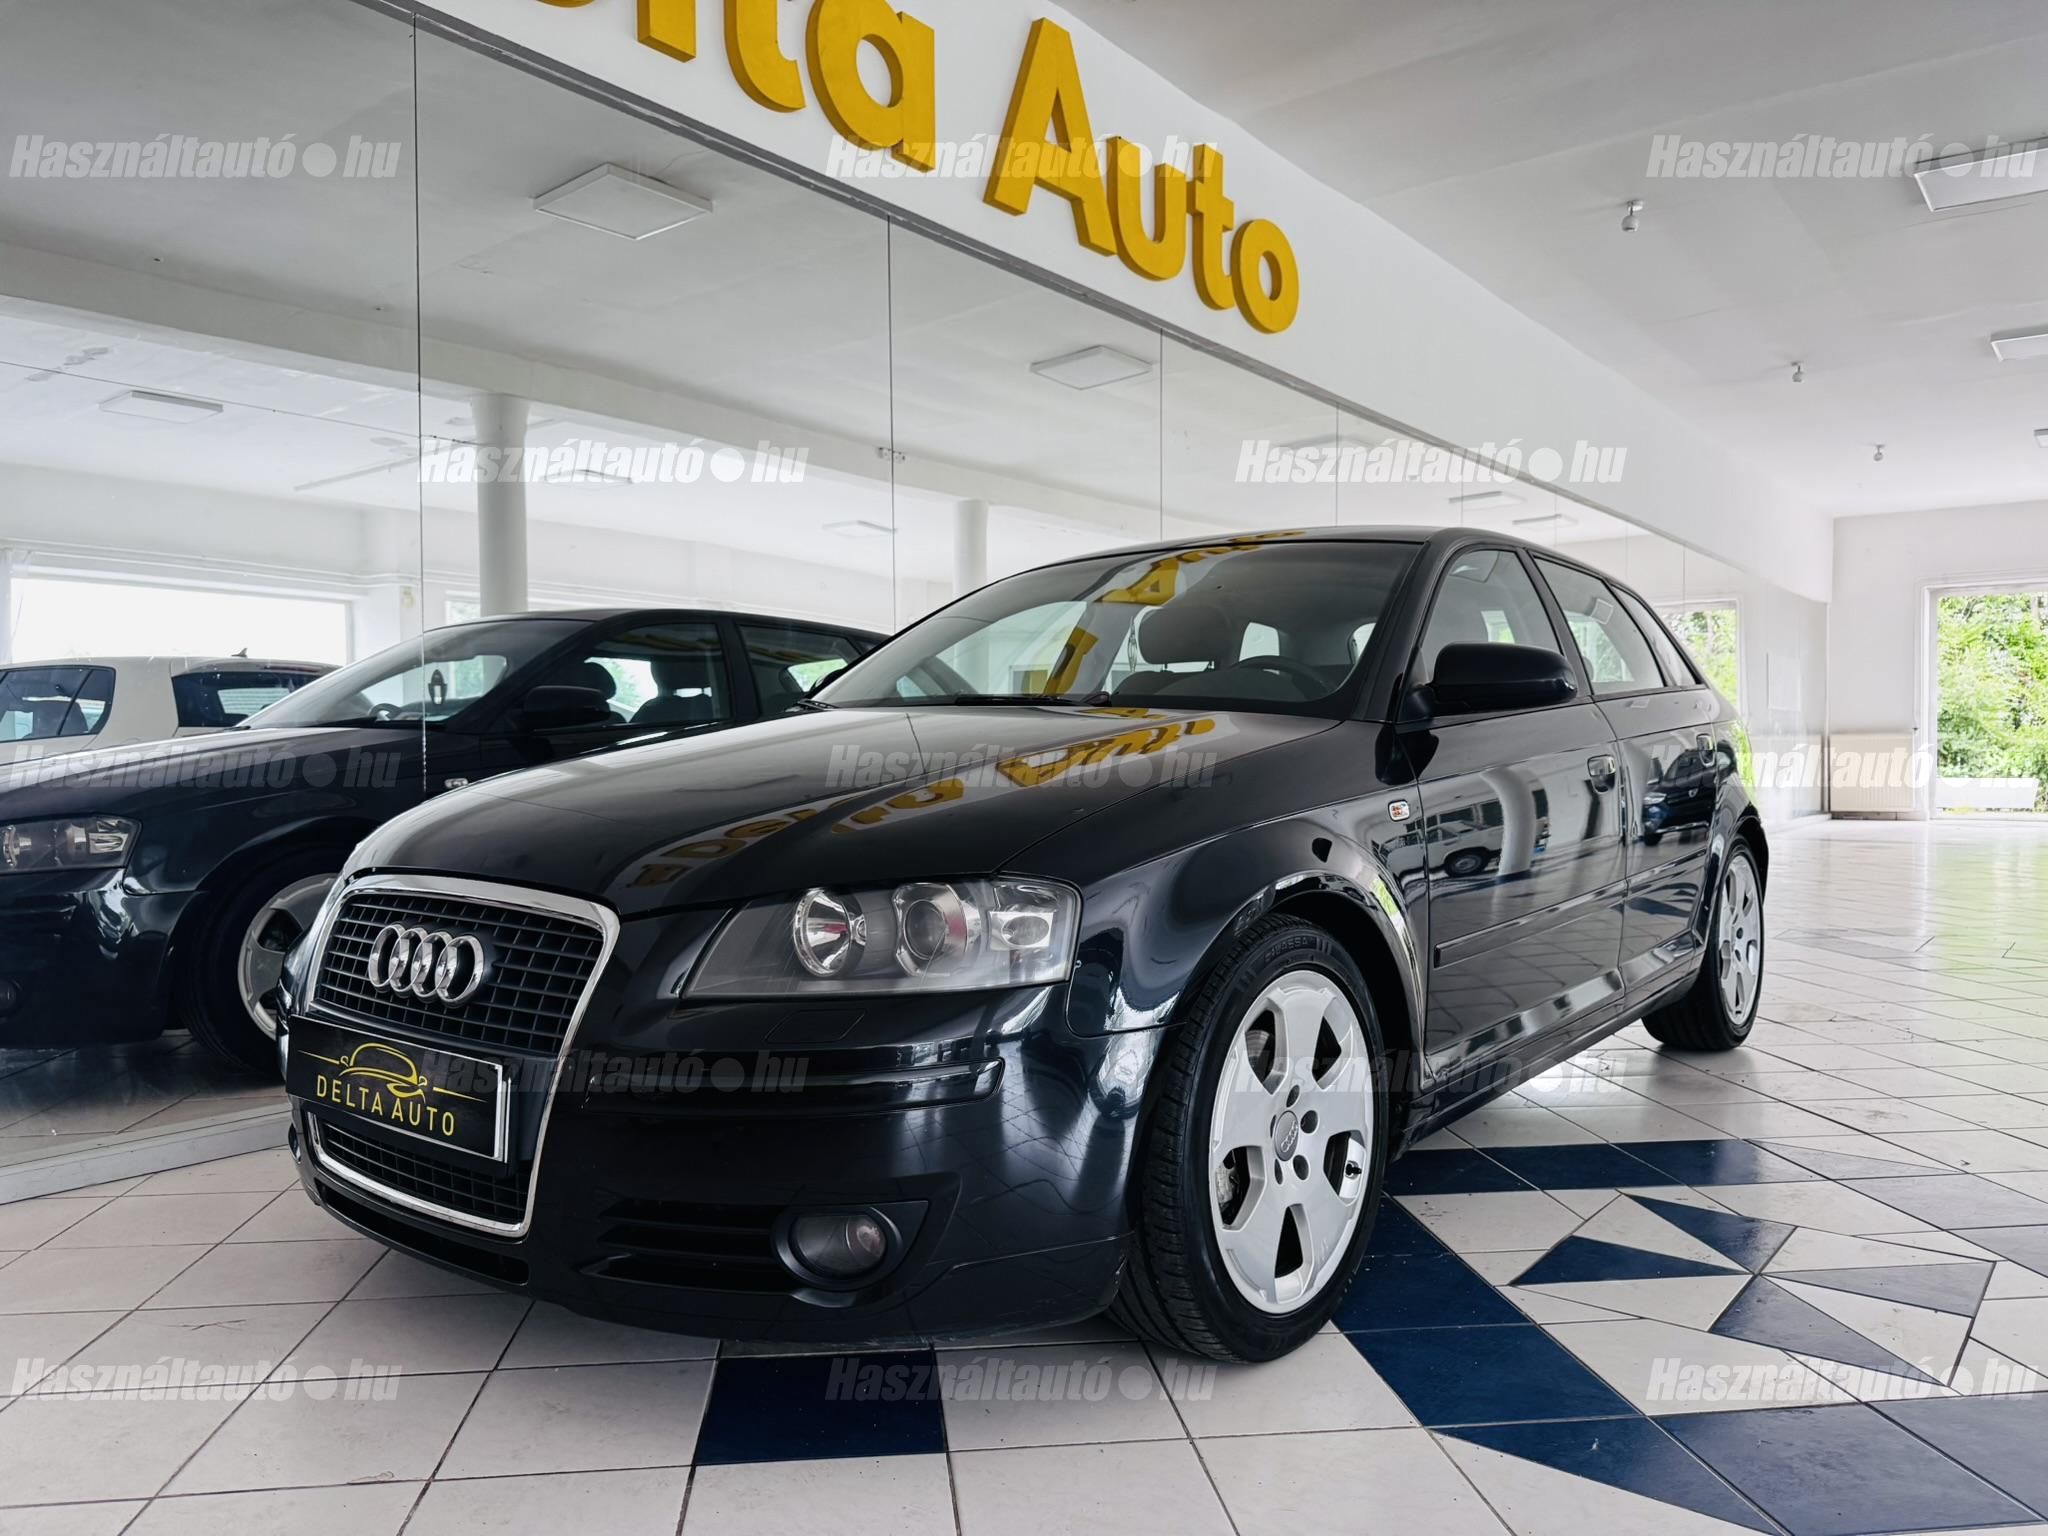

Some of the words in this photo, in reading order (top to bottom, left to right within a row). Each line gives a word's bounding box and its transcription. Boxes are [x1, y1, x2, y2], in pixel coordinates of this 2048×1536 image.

[527, 0, 936, 172] ta
[983, 17, 1299, 334] Auto
[316, 1074, 383, 1117] DELTA
[391, 1098, 455, 1137] AUTO
